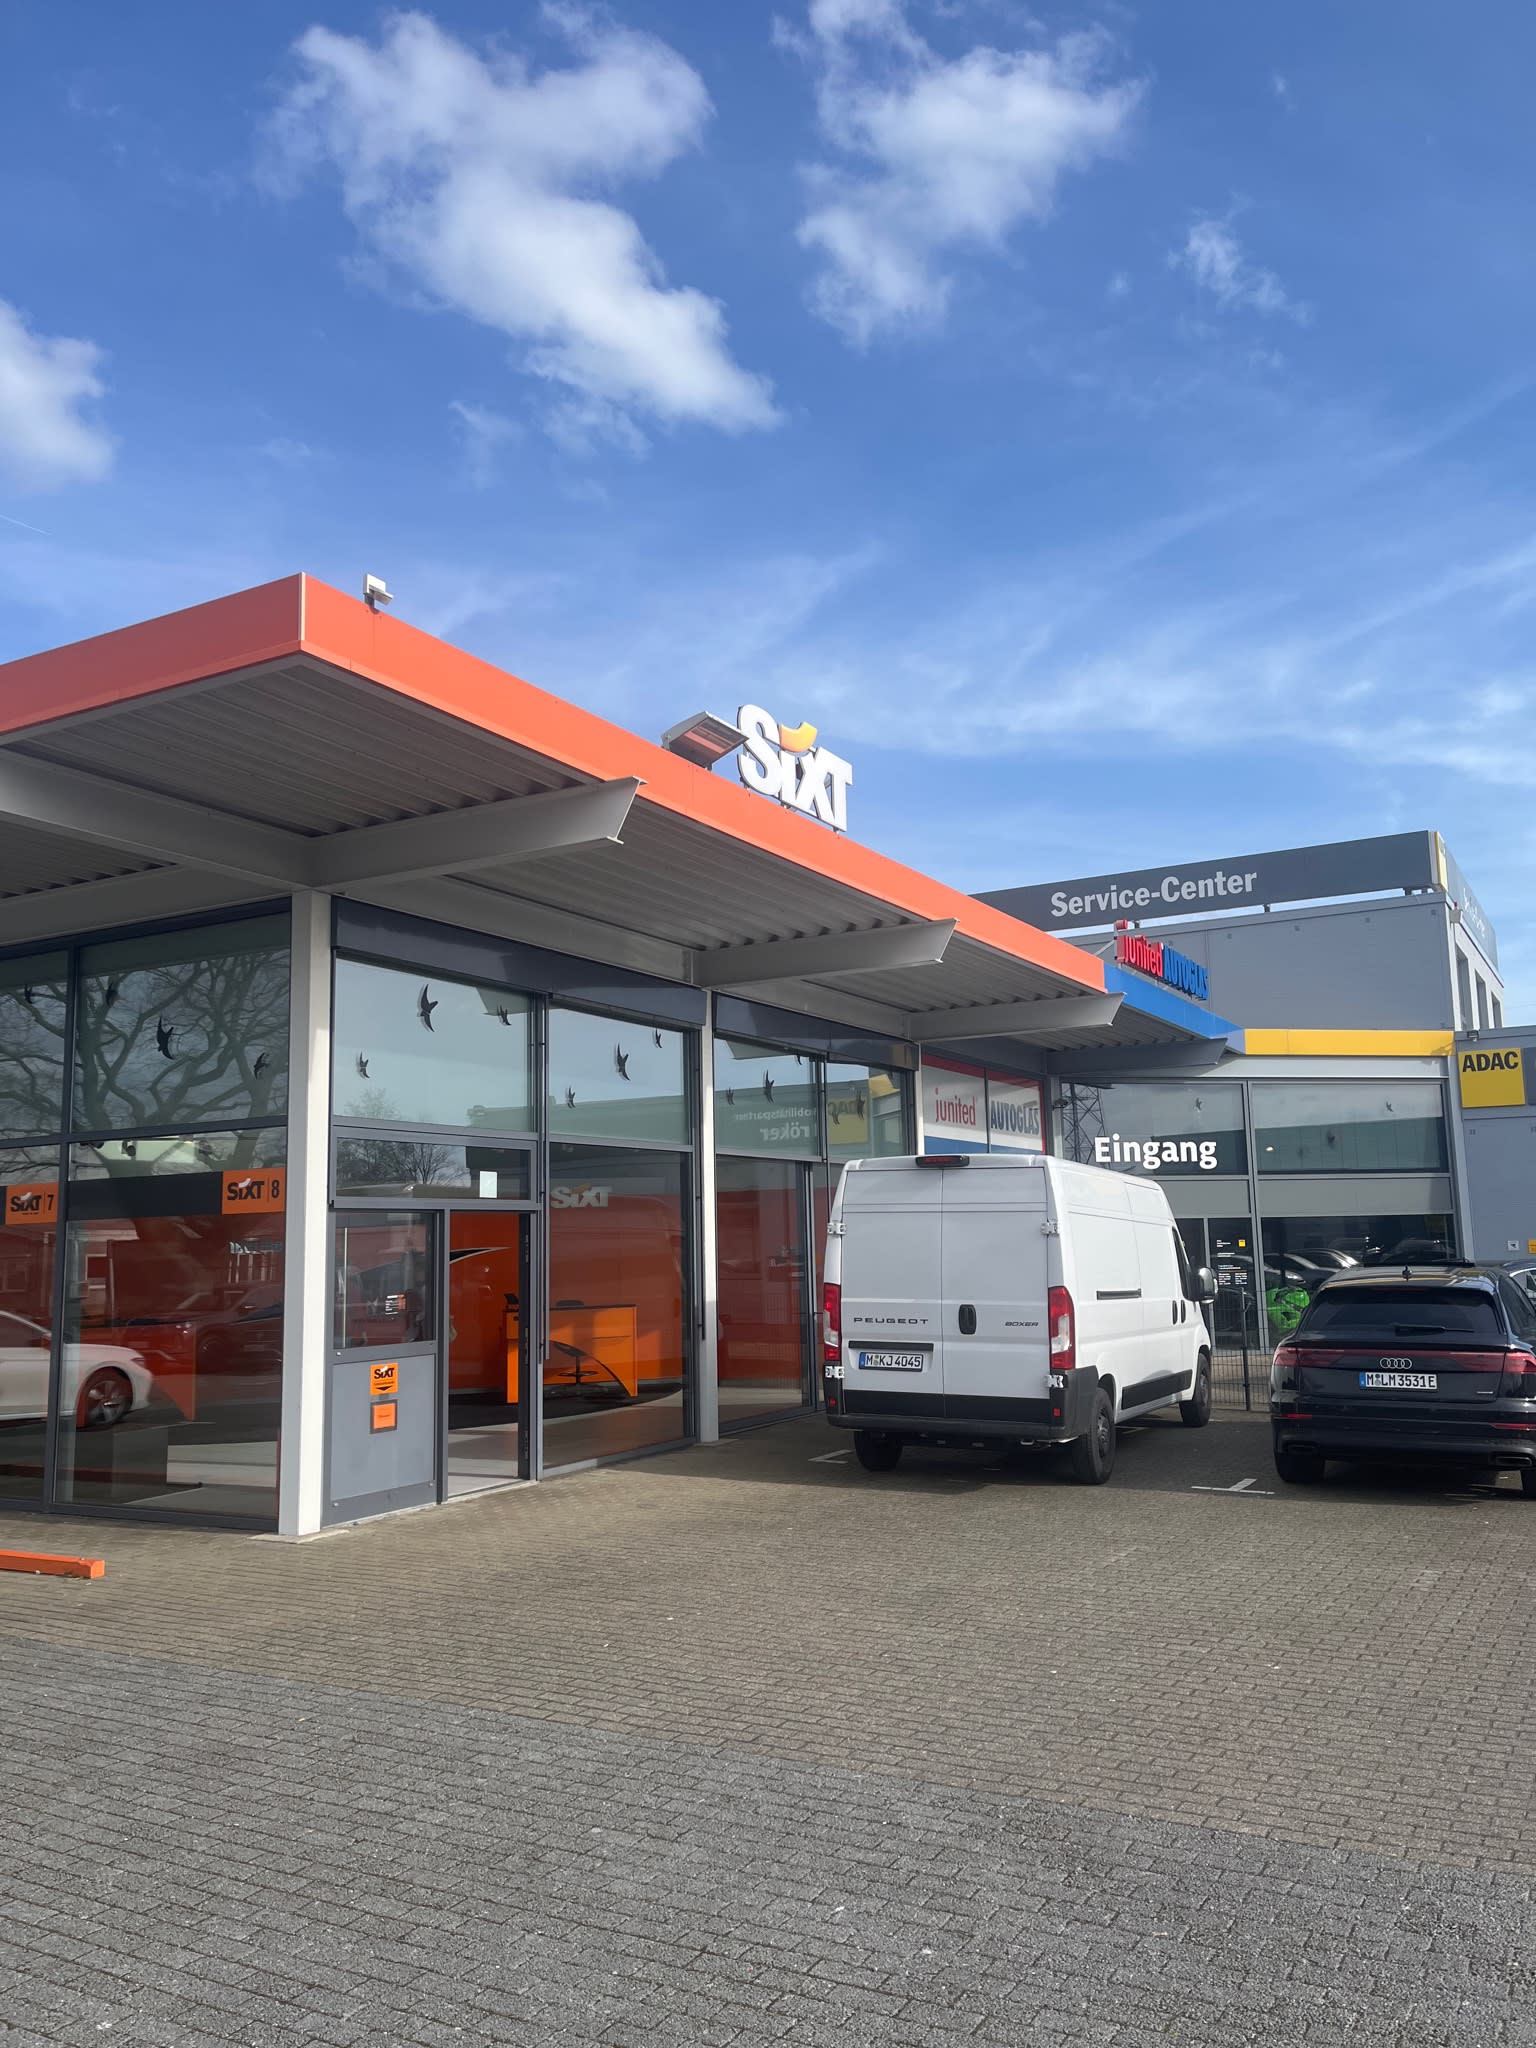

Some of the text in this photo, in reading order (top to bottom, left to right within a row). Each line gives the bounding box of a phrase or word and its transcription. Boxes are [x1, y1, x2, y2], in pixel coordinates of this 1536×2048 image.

[1050, 871, 1257, 917] Service-Center
[1463, 1051, 1518, 1072] ADAC
[935, 1087, 1040, 1135] junited AUTOGLAS
[1094, 1133, 1217, 1169] Eingang
[271, 1180, 280, 1198] 8
[47, 1194, 54, 1210] 7
[853, 1317, 929, 1325] PEUGEOT
